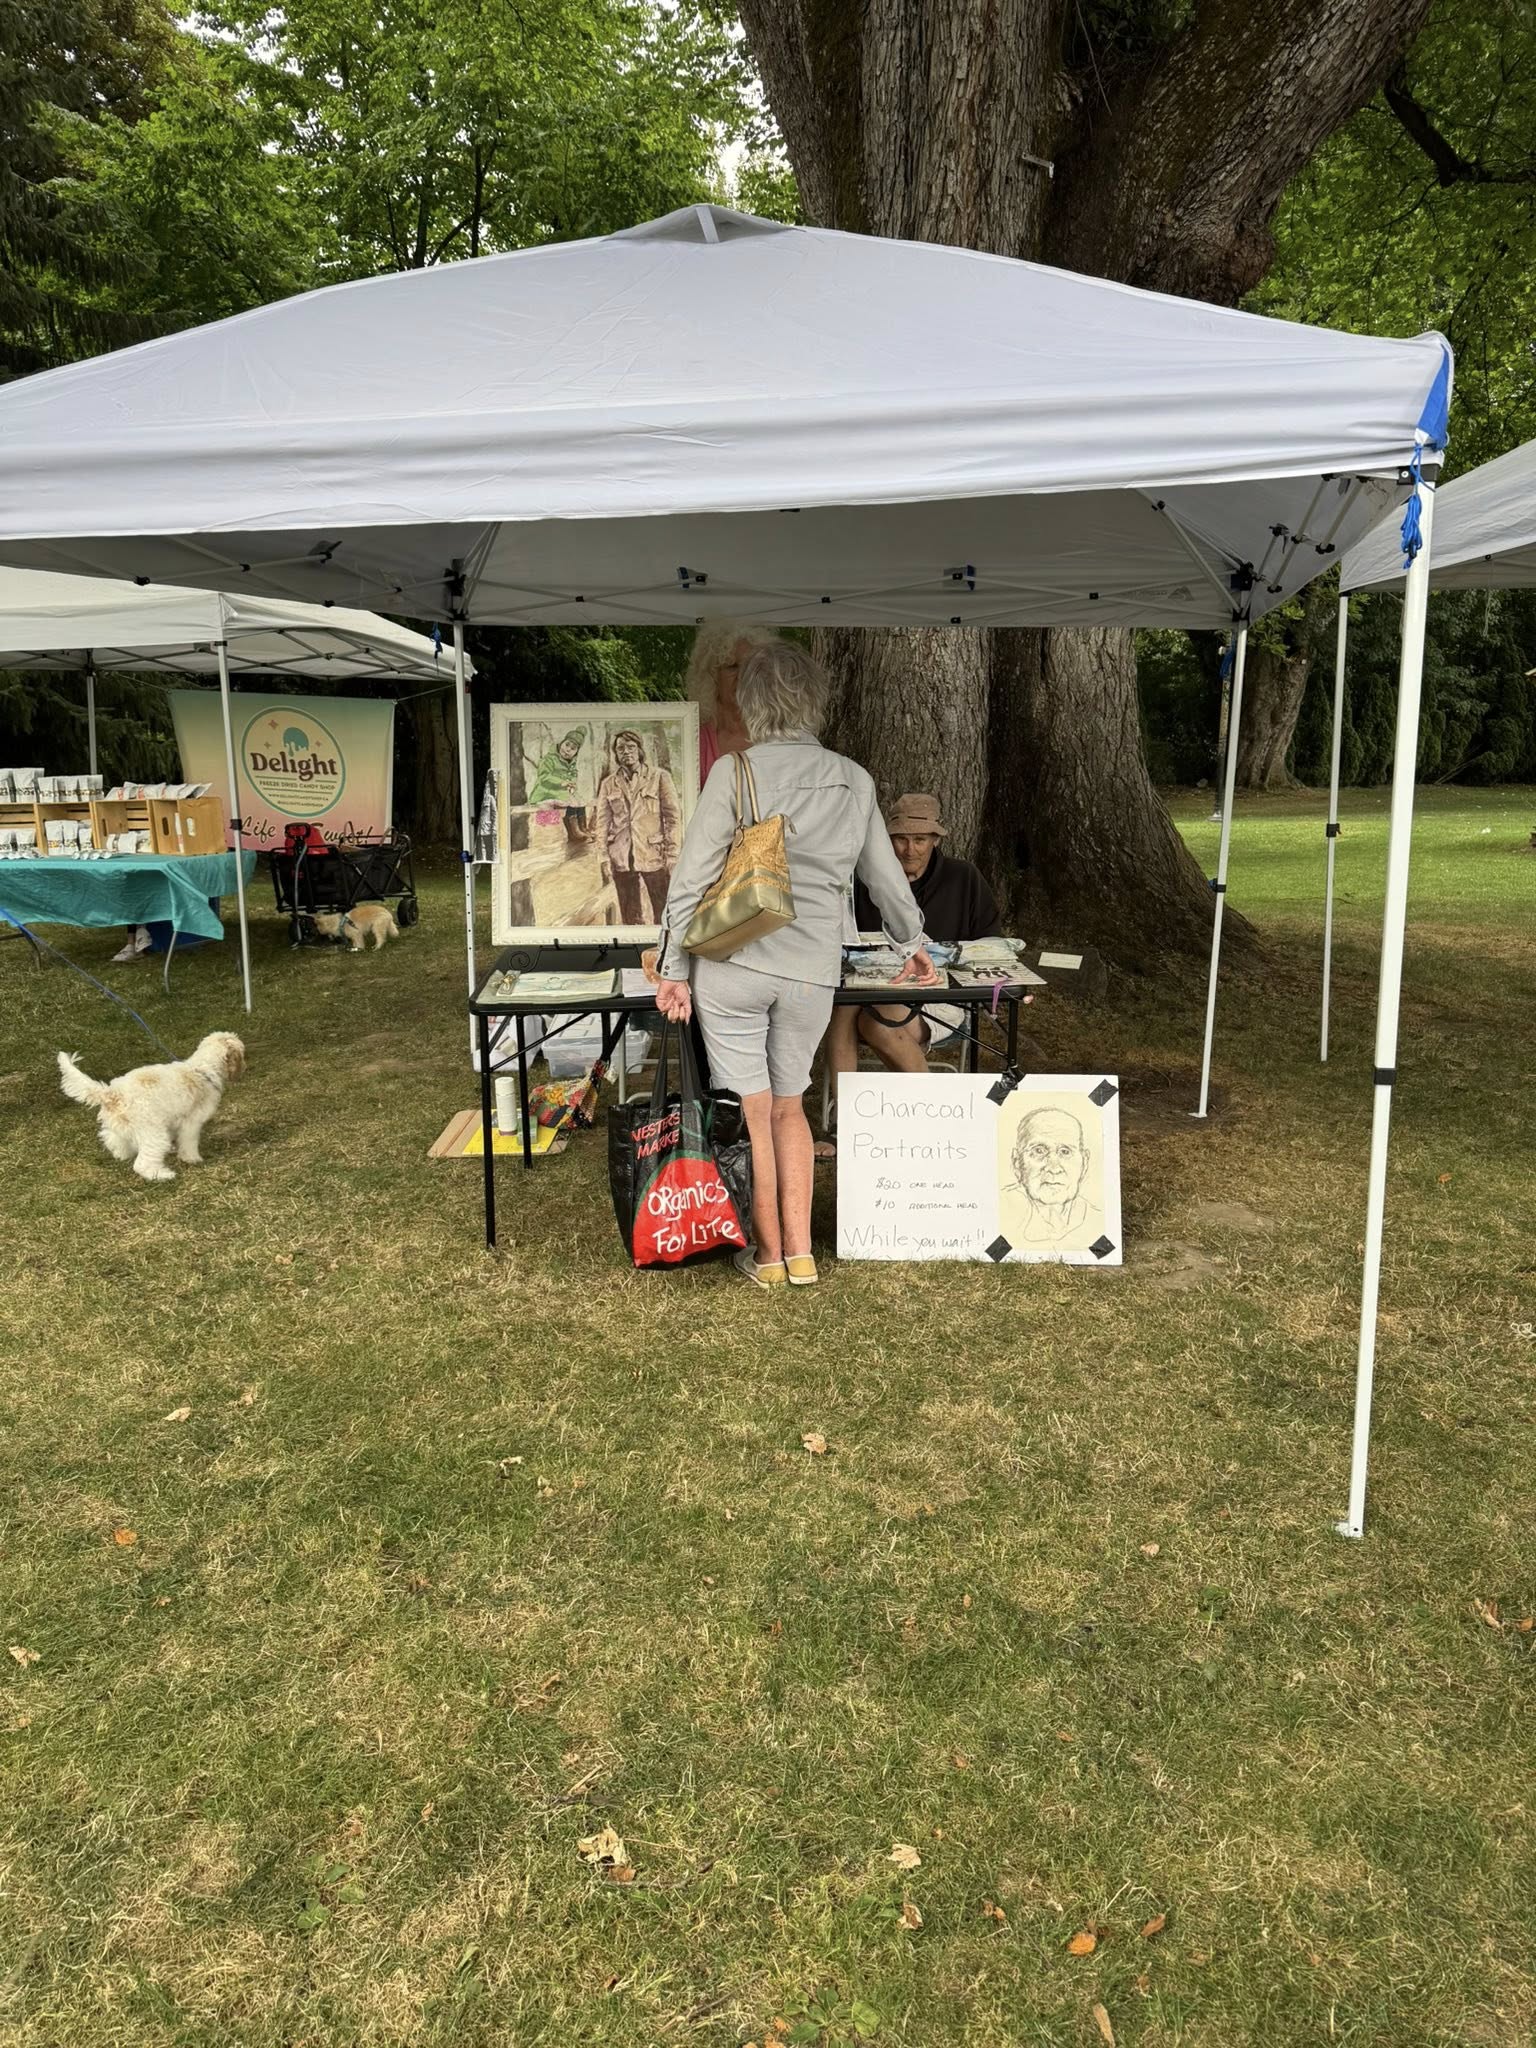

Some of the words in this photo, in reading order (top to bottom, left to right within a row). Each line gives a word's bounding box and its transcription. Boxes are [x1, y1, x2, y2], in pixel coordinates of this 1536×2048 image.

[250, 751, 338, 781] Delight
[854, 1090, 974, 1120] Charcoal
[636, 1128, 680, 1161] MARKE
[853, 1132, 967, 1160] Portraits
[876, 1176, 902, 1191] $20
[932, 1181, 955, 1189] HEAD
[875, 1197, 896, 1210] $10
[908, 1202, 952, 1210] ADDITIONAL
[844, 1224, 909, 1248] While
[912, 1237, 937, 1252] you
